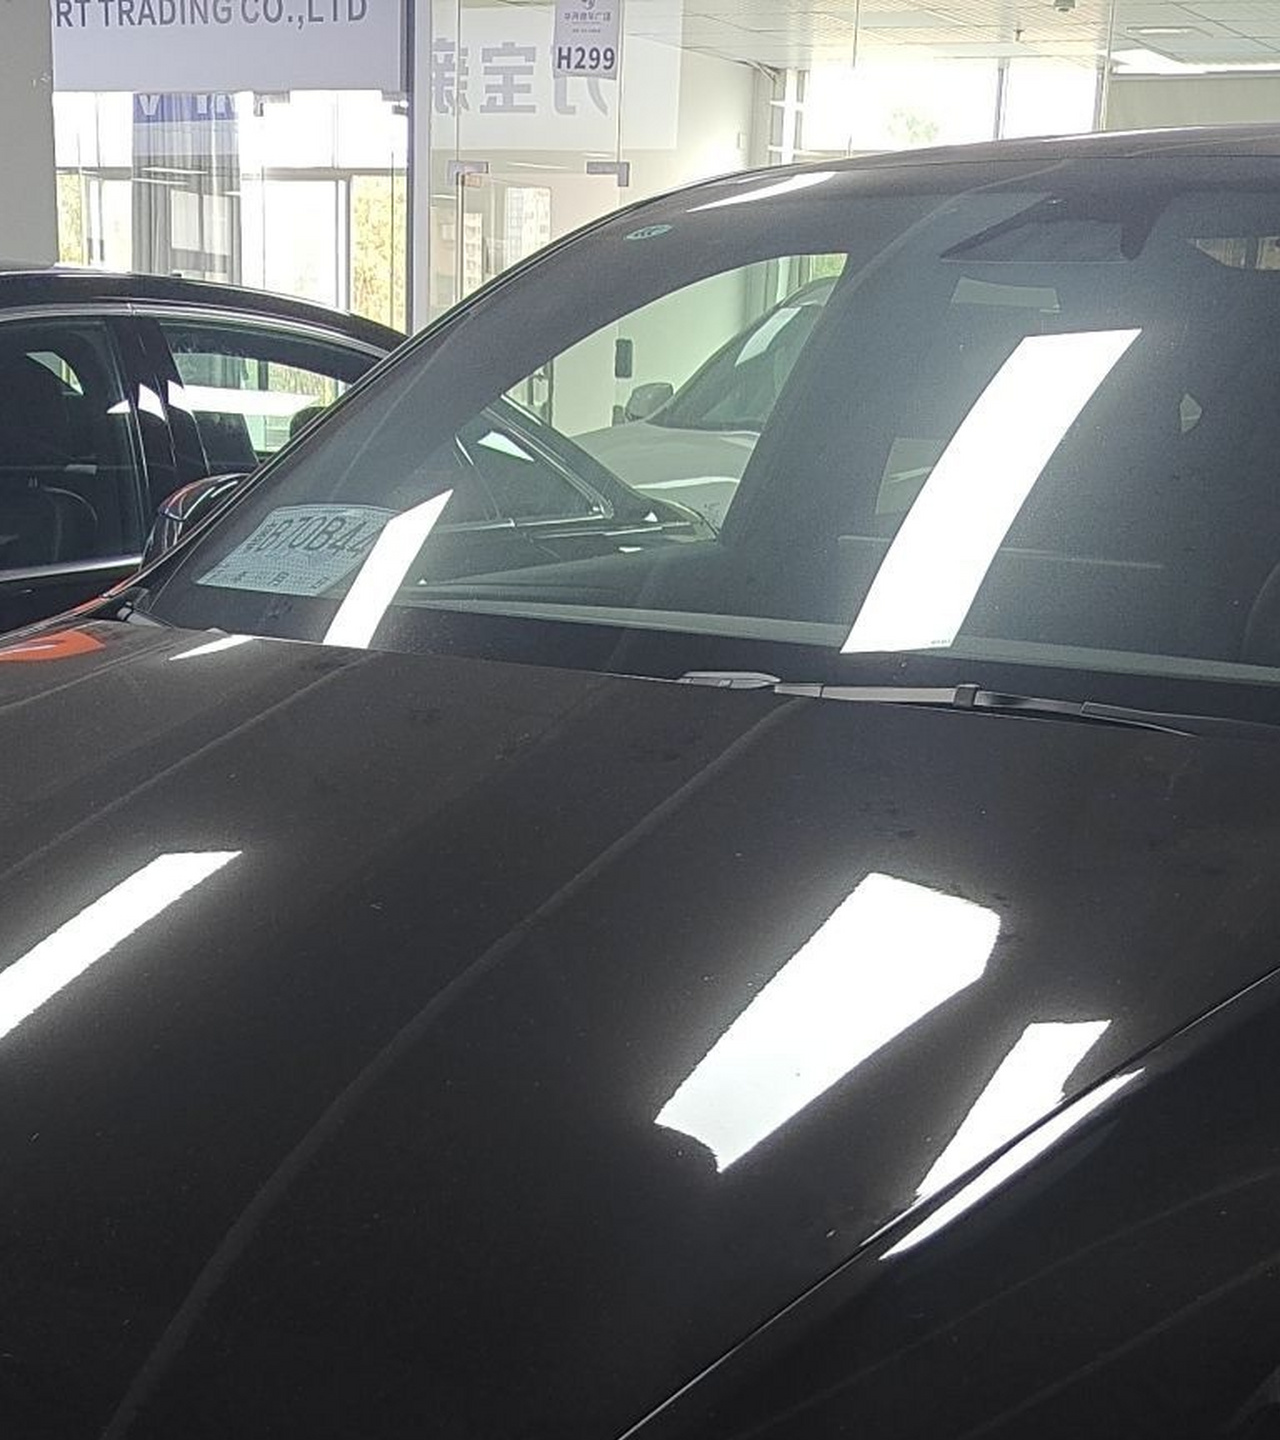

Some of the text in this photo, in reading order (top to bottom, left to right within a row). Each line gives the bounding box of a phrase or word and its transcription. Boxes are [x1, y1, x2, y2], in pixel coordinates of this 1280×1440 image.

[56, 0, 88, 27] RT
[97, 0, 233, 28] TRADING
[557, 46, 615, 70] H299
